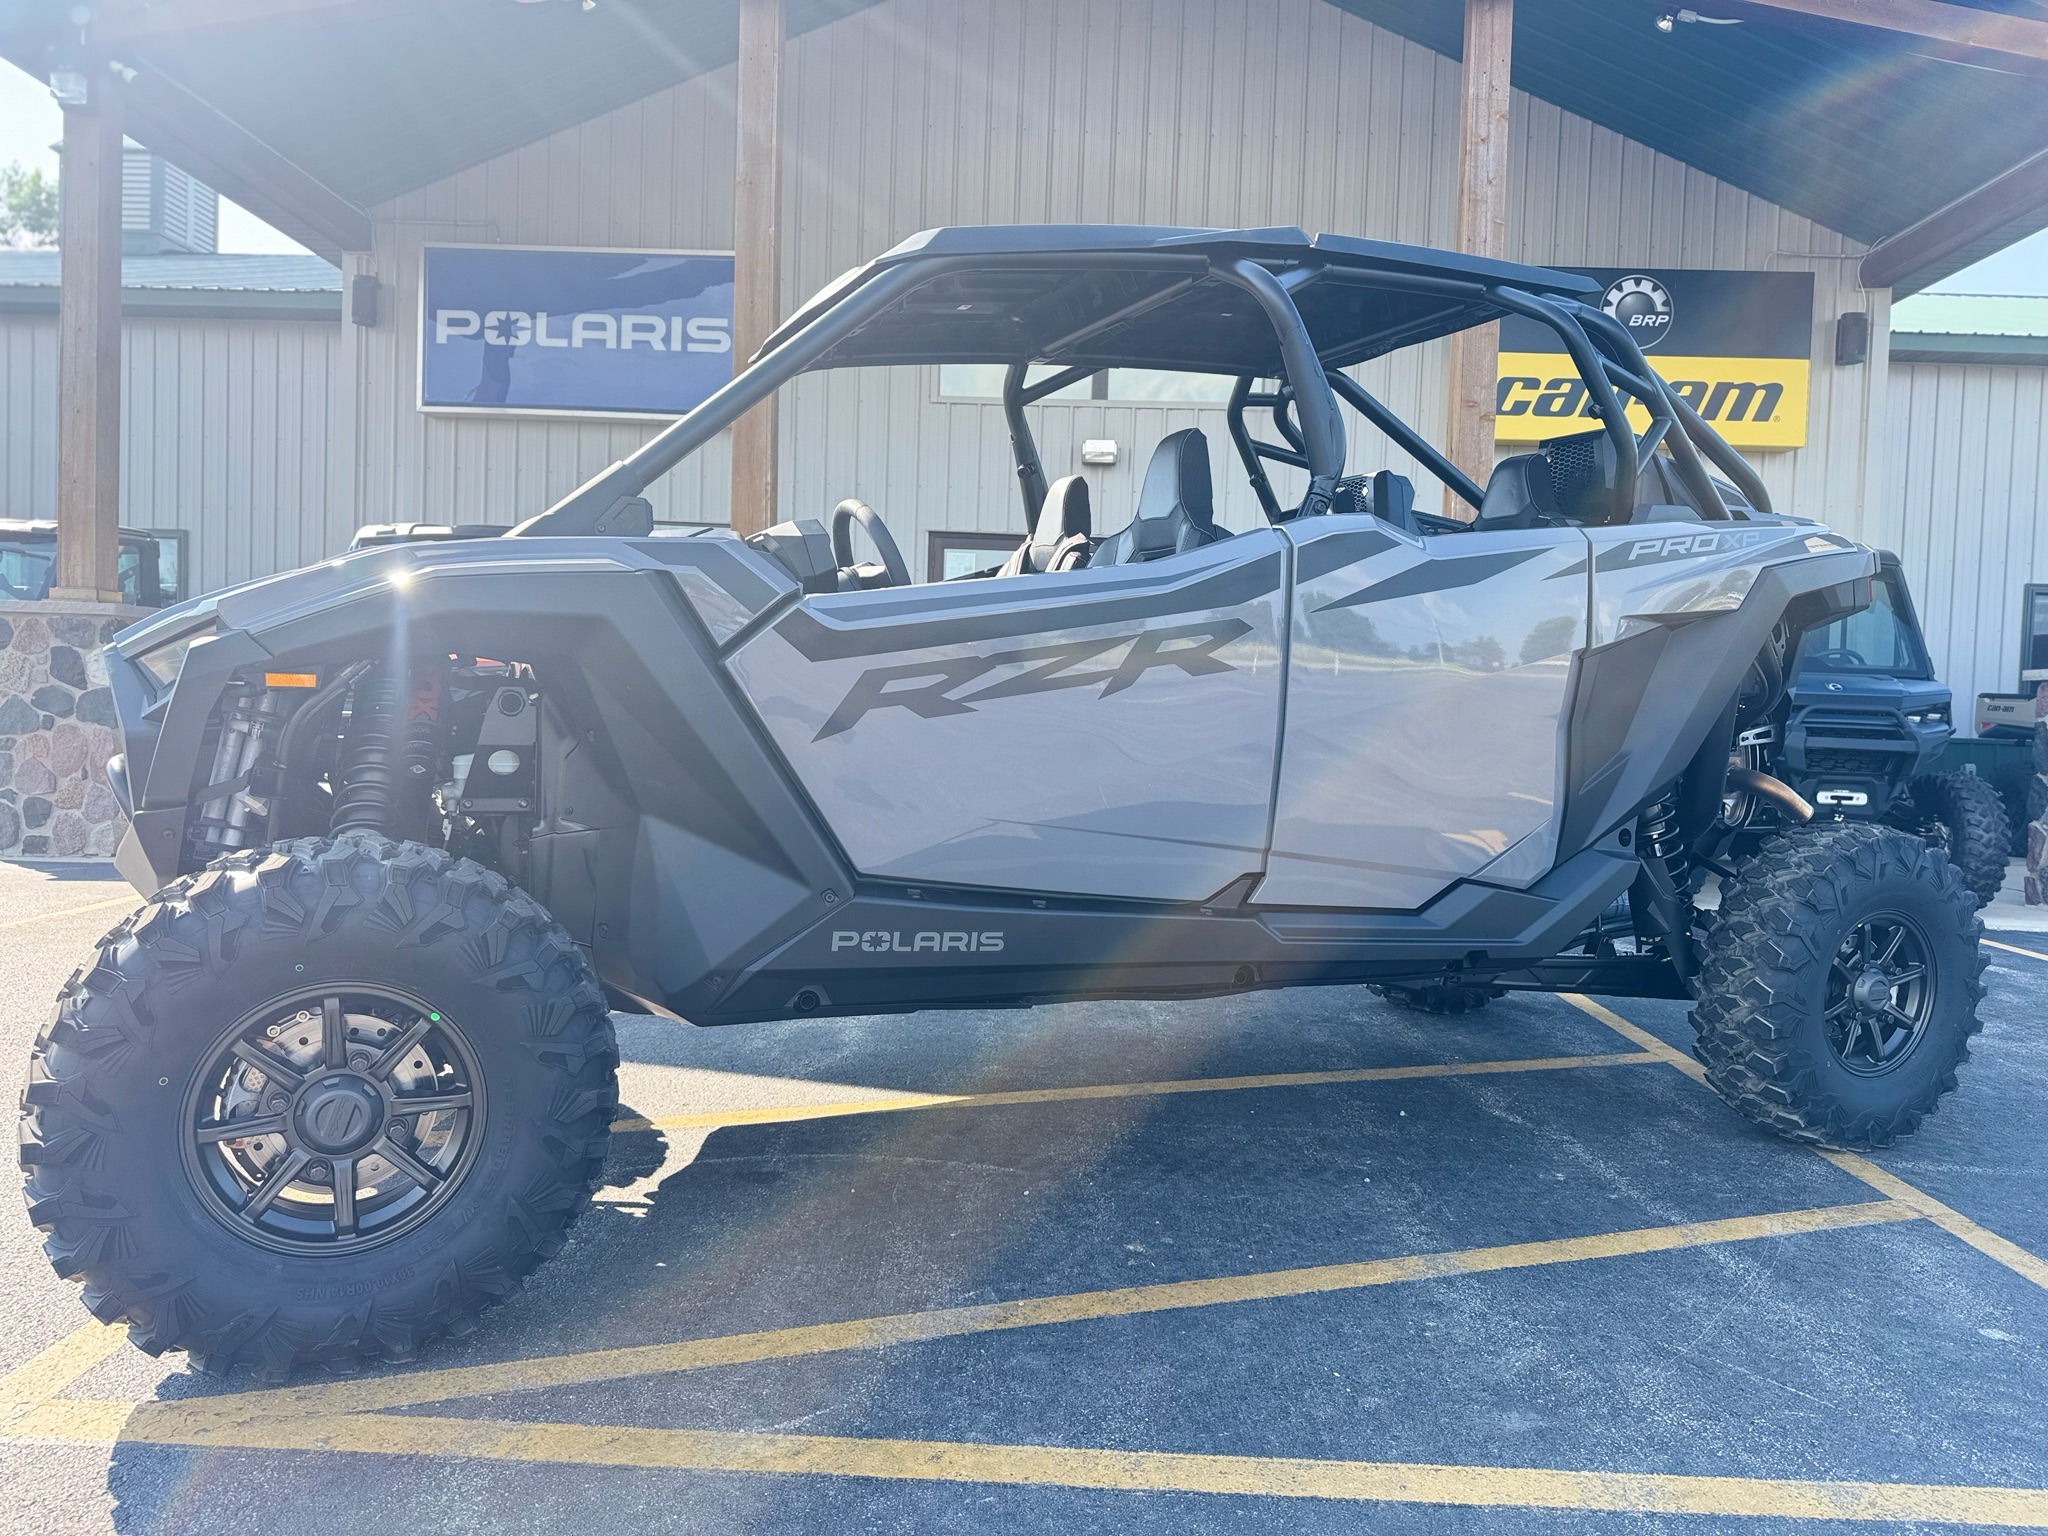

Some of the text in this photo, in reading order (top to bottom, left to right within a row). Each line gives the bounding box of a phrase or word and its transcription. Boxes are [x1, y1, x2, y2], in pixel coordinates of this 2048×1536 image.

[435, 309, 732, 353] POLARIS
[1629, 314, 1670, 327] BRP
[1628, 531, 1759, 560] PRO XP
[810, 617, 1255, 743] RZR
[1987, 704, 2015, 713] can-am
[831, 931, 1005, 952] POLARIS
[294, 1286, 327, 1301] NHS
